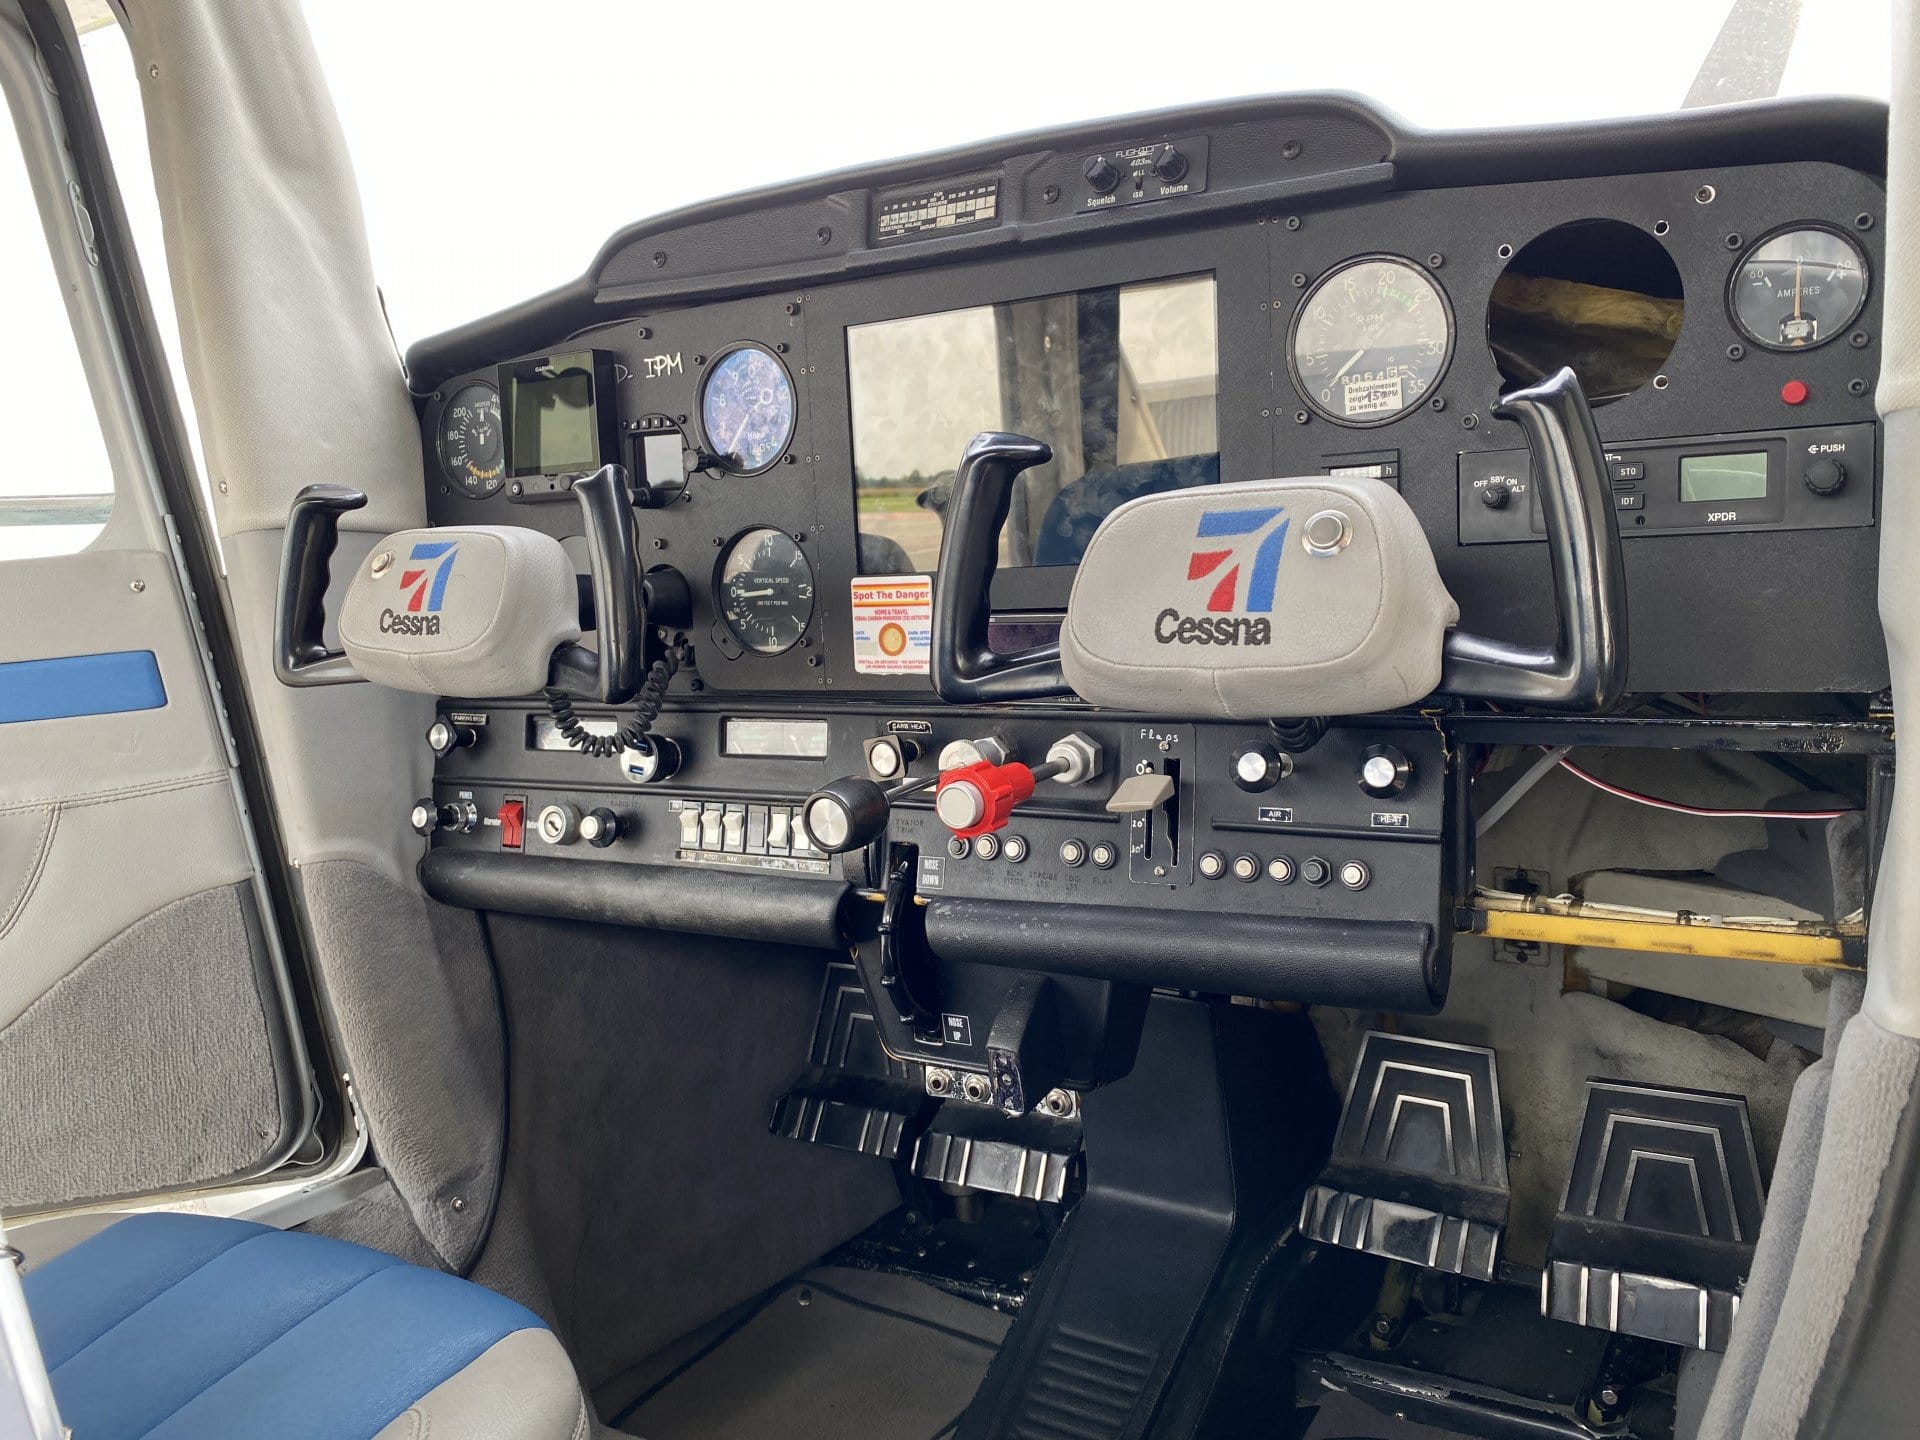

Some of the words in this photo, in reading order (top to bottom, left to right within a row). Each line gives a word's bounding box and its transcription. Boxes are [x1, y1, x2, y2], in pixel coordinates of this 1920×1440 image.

[1160, 184, 1188, 195] Volume
[1087, 195, 1116, 208] Squelch
[1378, 271, 1395, 285] 20
[1749, 269, 1764, 279] 60
[1344, 278, 1356, 291] 15
[1415, 288, 1431, 302] 25
[1314, 306, 1325, 320] 10
[1357, 314, 1384, 324] RPM
[1426, 341, 1445, 355] 30
[1306, 353, 1314, 366] 5
[644, 352, 683, 379] IPM
[1348, 382, 1398, 394] Drehzahlmesser
[1408, 379, 1426, 393] 35
[1322, 389, 1331, 402] 0
[1359, 402, 1377, 410] wenig
[453, 407, 467, 418] 200
[448, 431, 459, 440] 180
[1820, 443, 1846, 453] PUSH
[452, 456, 463, 466] 160
[1620, 468, 1636, 476] STO
[466, 476, 478, 485] 140
[486, 480, 498, 489] 120
[1473, 480, 1488, 488] OFF
[1506, 478, 1518, 486] ON
[1511, 485, 1526, 493] ALT
[1621, 497, 1635, 505] IDT
[1707, 512, 1736, 522] XPDR
[764, 535, 773, 545] 10
[739, 554, 744, 564] 5
[795, 551, 803, 560] 15
[731, 587, 736, 597] 0
[806, 587, 812, 597] 2
[853, 591, 874, 600] Spot
[876, 591, 893, 599] The
[896, 590, 929, 600] Danger
[379, 608, 440, 635] Cessna
[740, 619, 746, 630] 5
[798, 623, 805, 632] 15
[1154, 608, 1271, 646] Cessna
[769, 637, 777, 648] 10
[1140, 728, 1179, 743] Flaps
[1268, 810, 1282, 818] AIR
[1380, 815, 1402, 825] HEAT
[924, 859, 939, 870] NOSE
[922, 874, 939, 886] DOWN
[948, 1017, 963, 1028] NOSE
[953, 1031, 961, 1041] UP
